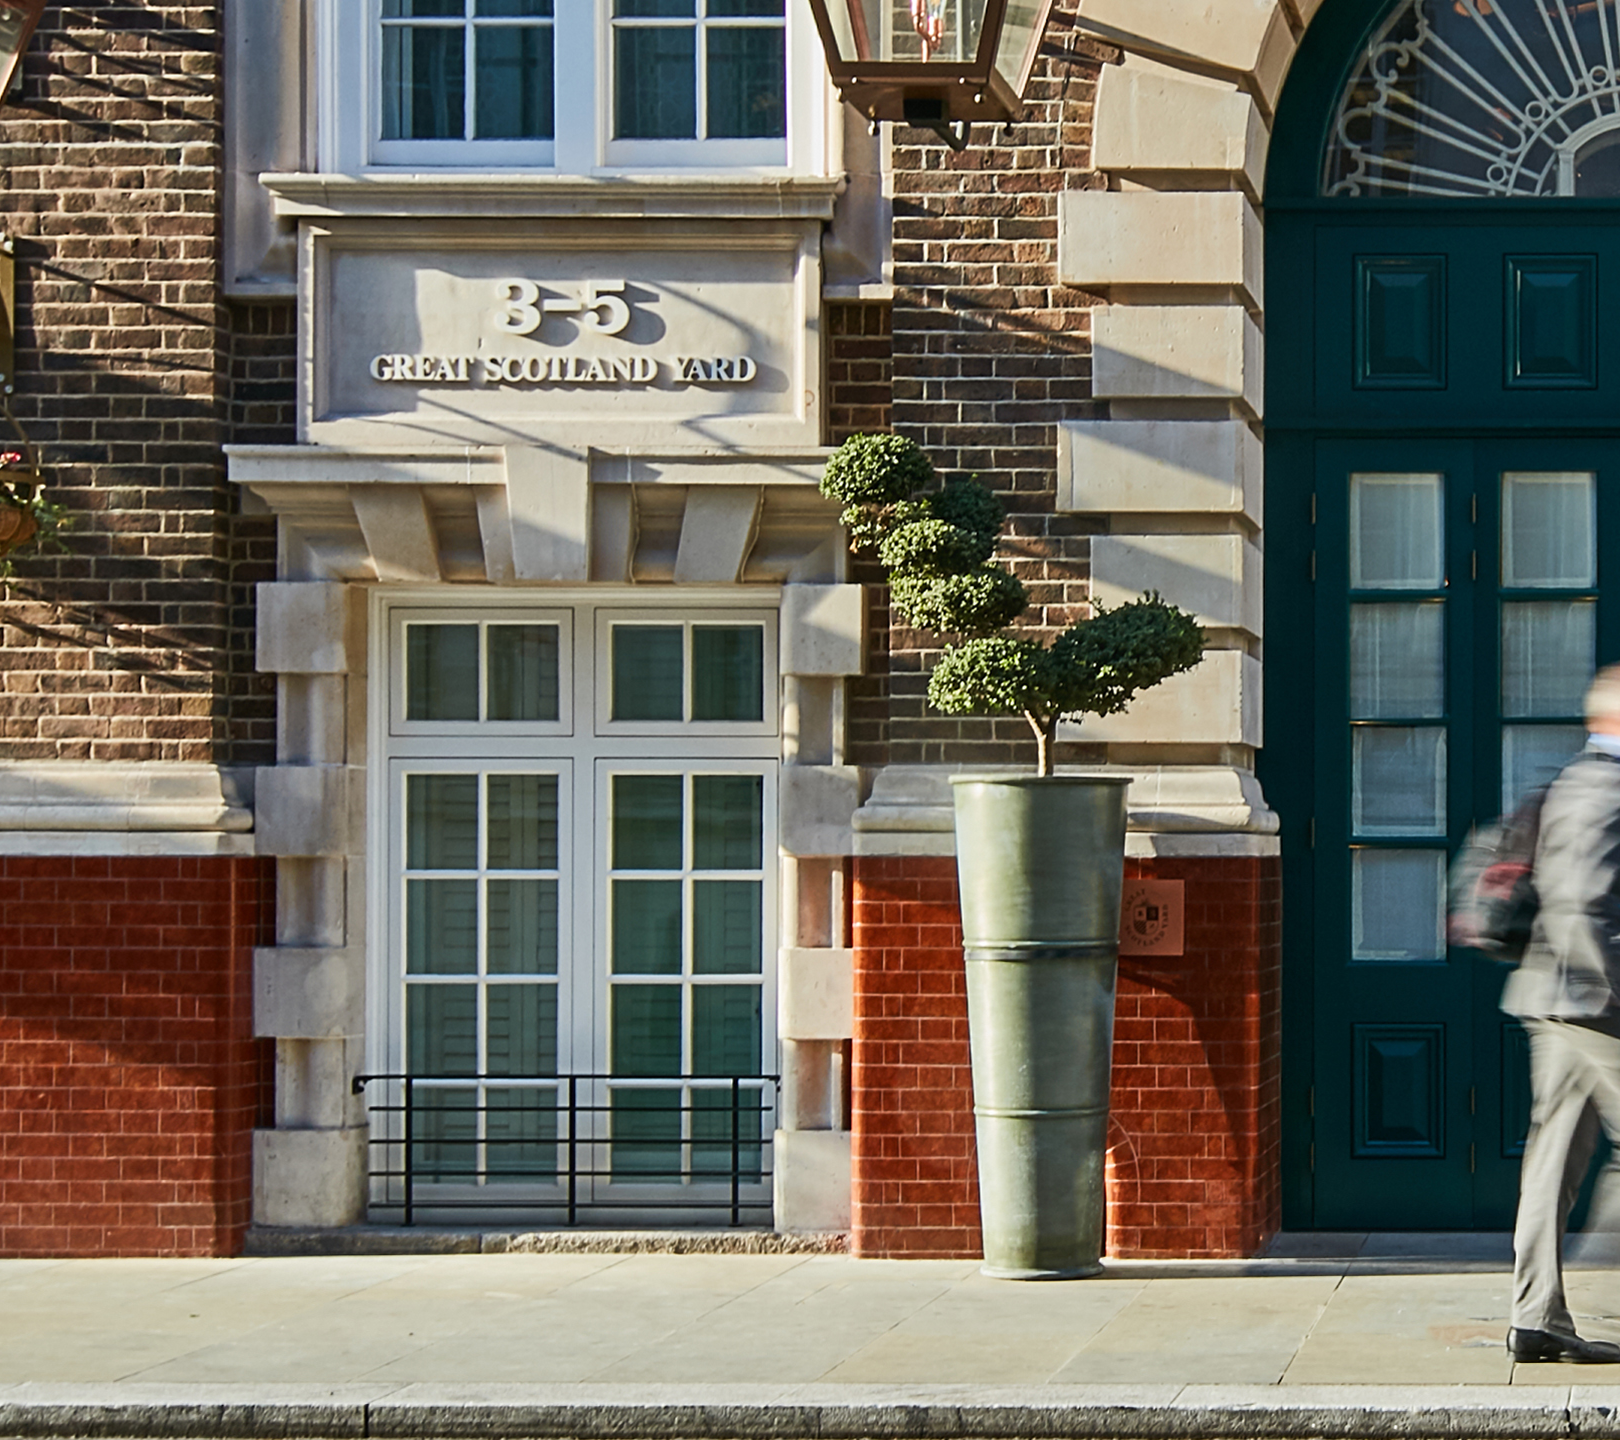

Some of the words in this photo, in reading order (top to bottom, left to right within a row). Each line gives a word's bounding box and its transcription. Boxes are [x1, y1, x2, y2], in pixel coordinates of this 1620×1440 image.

[369, 353, 476, 382] GREAT
[483, 353, 658, 382] SCOTLAND
[670, 354, 757, 382] YARD
